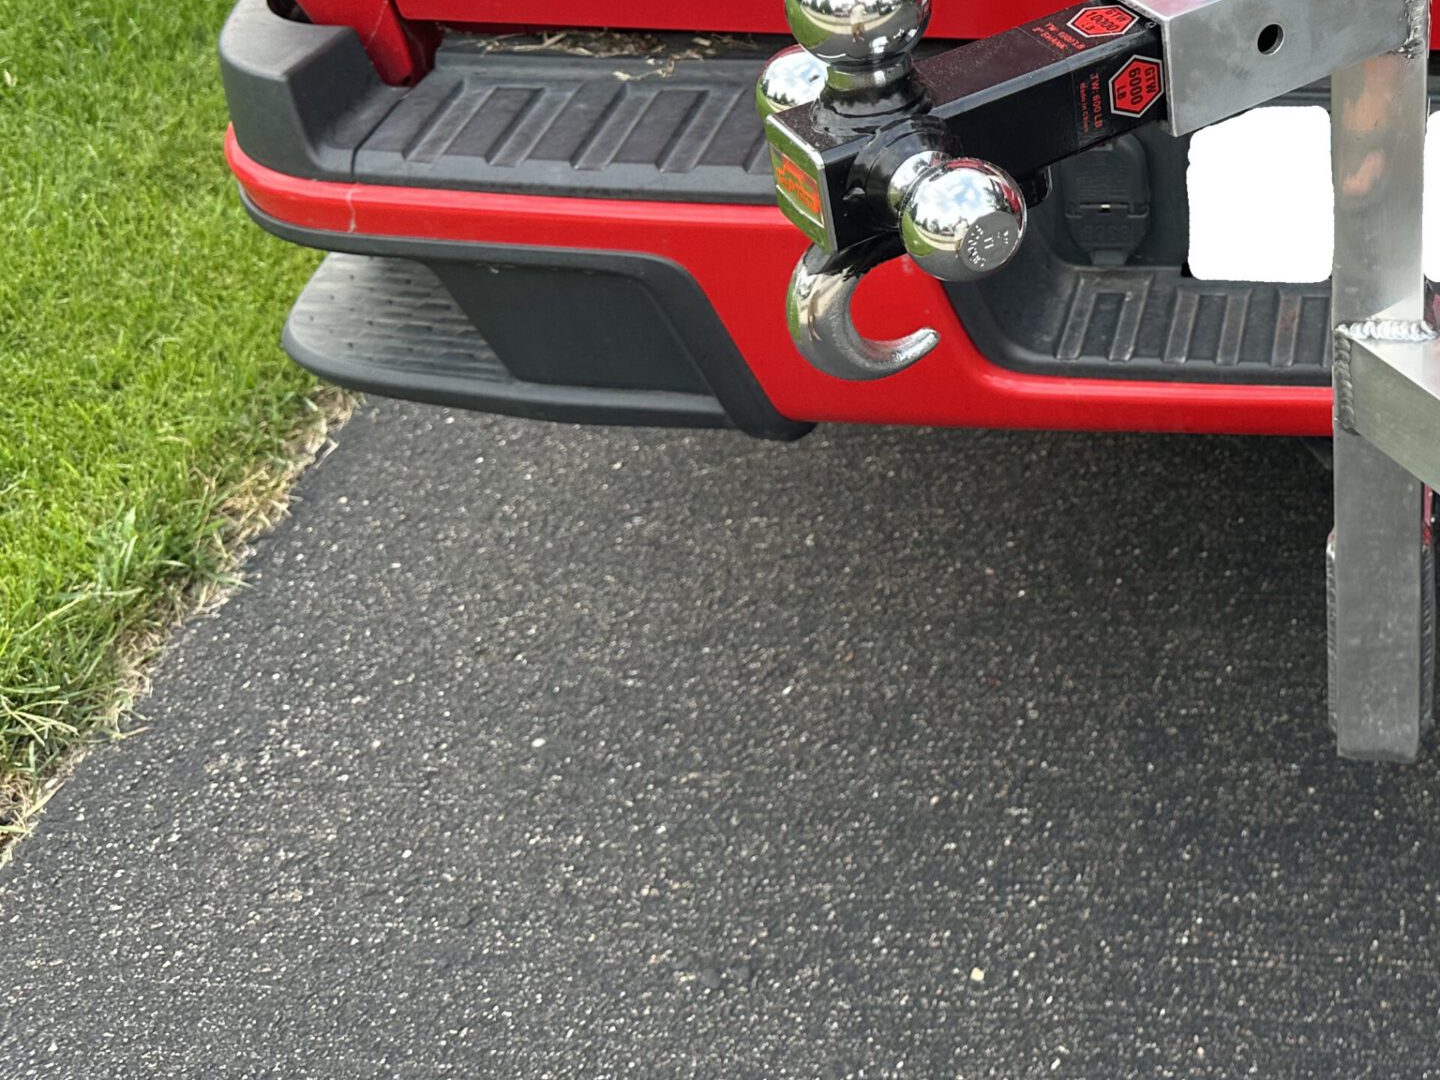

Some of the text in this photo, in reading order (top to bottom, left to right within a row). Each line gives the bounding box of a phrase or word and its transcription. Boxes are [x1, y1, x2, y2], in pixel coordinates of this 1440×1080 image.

[1117, 85, 1127, 100] LB
[1129, 67, 1144, 106] 6000
[1145, 66, 1156, 94] GTW
